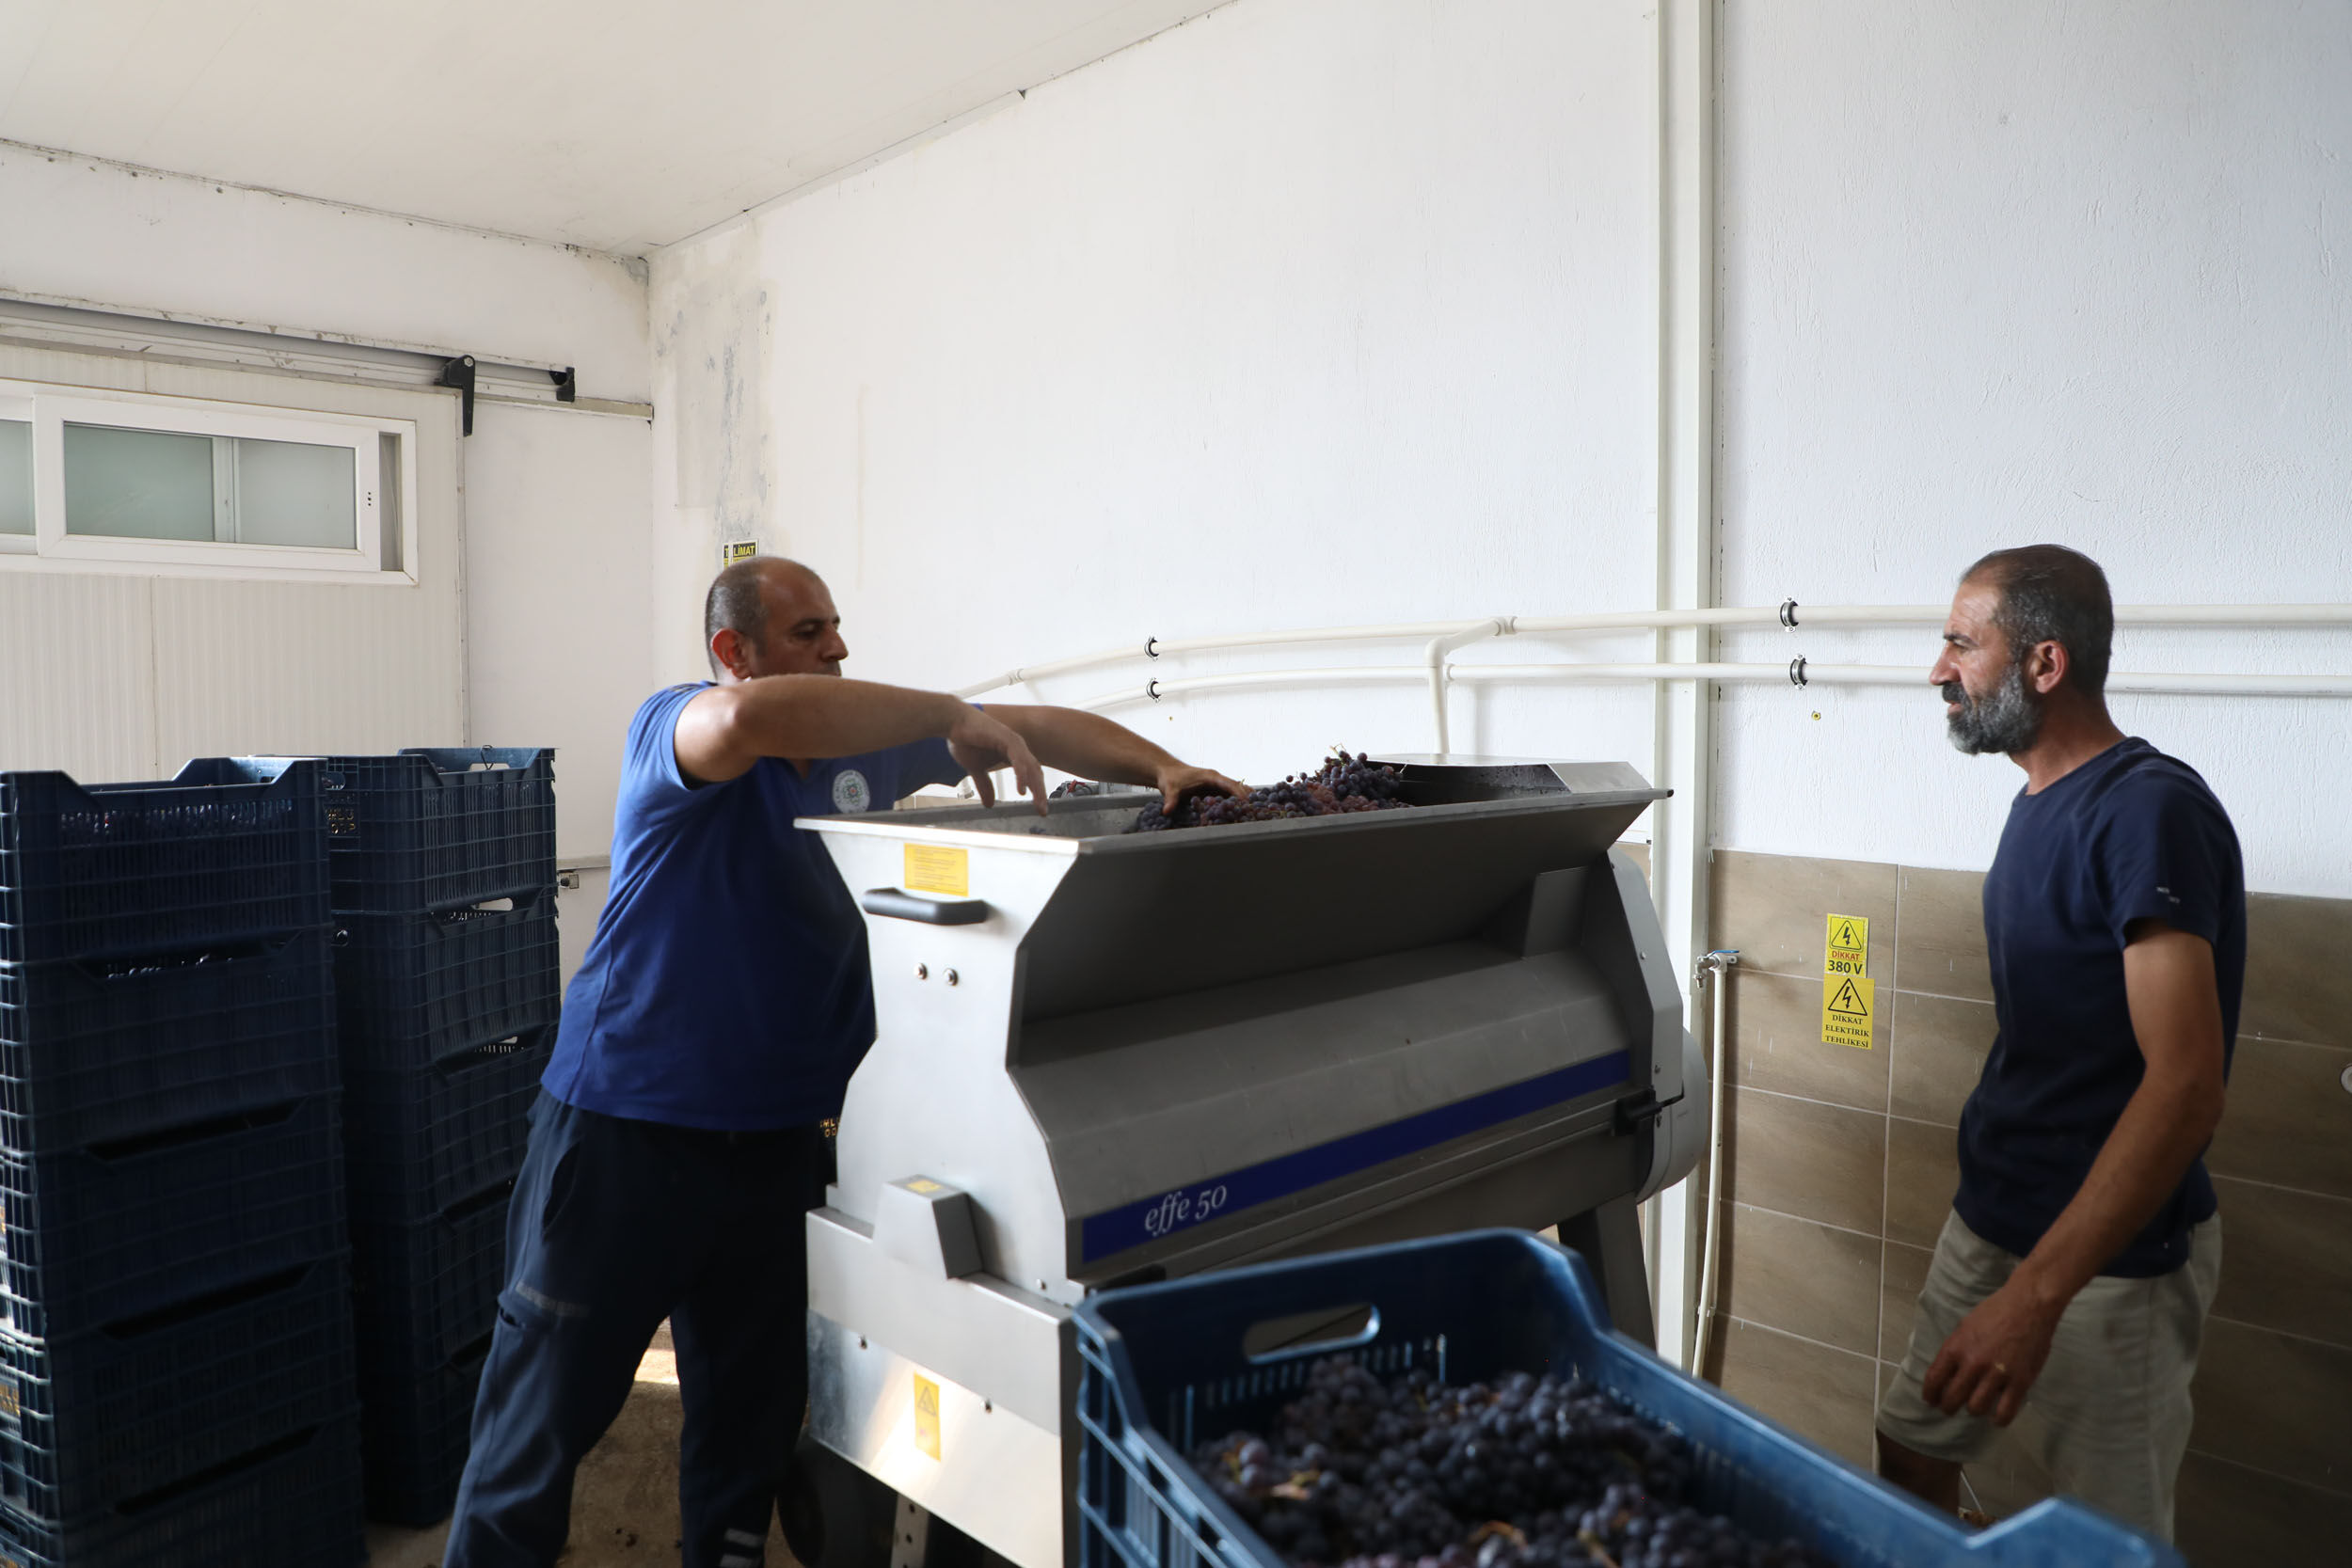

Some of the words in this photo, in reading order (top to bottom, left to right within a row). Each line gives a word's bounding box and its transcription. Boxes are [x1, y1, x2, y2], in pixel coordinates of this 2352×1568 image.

[724, 545, 755, 557] TLİMAT
[1828, 959, 1851, 974] 380
[1853, 962, 1863, 974] V
[1832, 1014, 1864, 1025] DİKKAT
[1825, 1035, 1868, 1048] TEHLİKESİ
[1144, 1191, 1190, 1237] effe
[1194, 1185, 1227, 1220] 50
